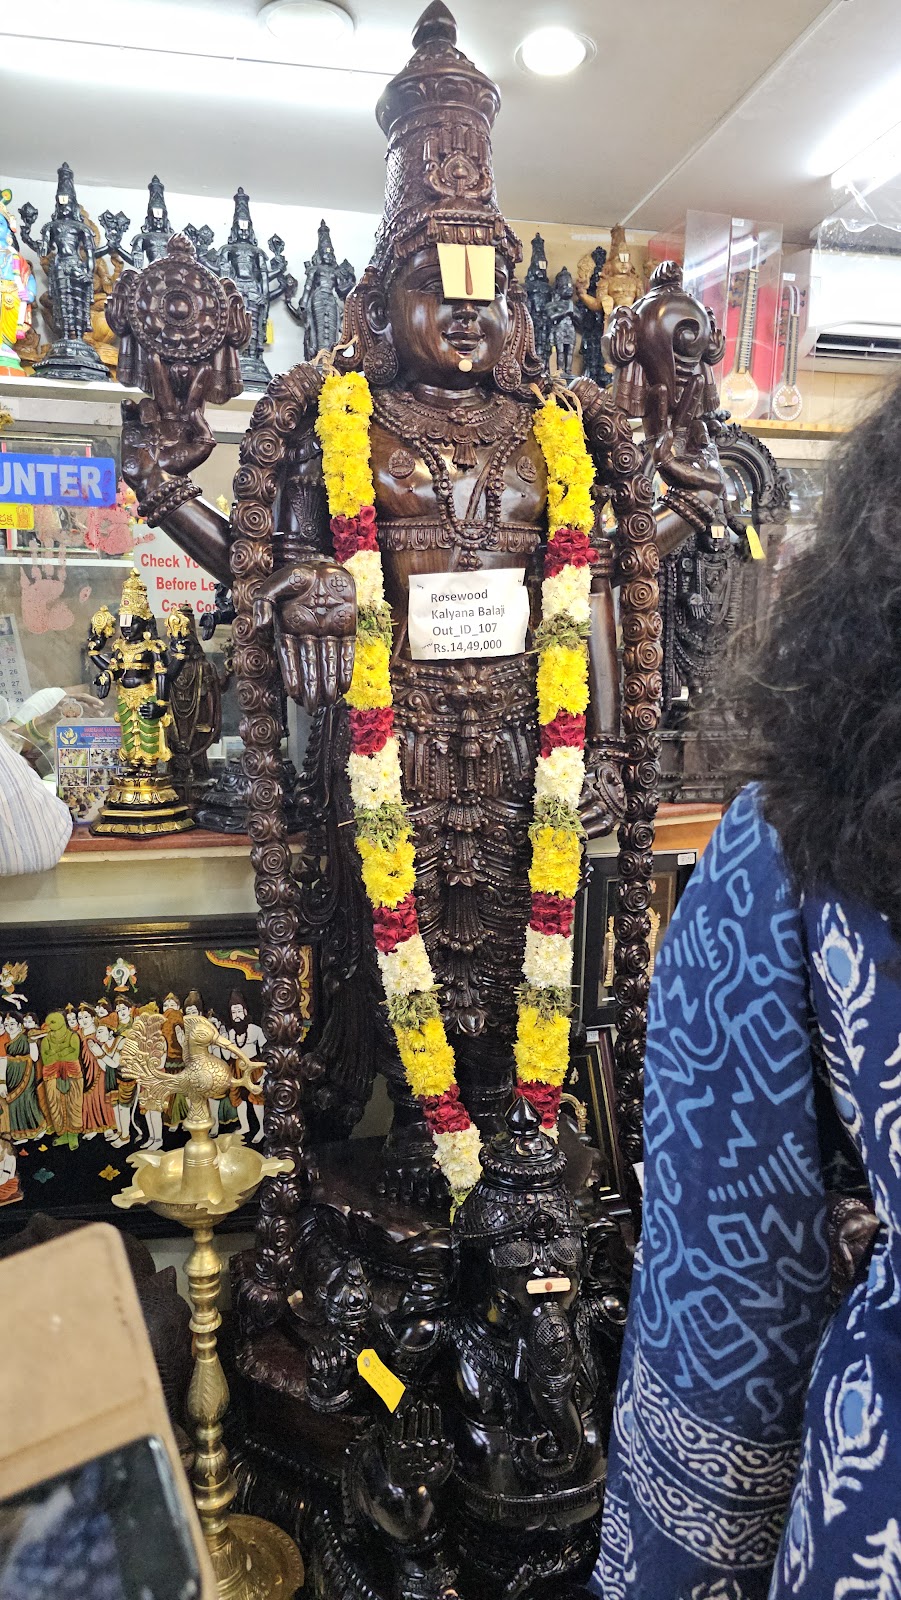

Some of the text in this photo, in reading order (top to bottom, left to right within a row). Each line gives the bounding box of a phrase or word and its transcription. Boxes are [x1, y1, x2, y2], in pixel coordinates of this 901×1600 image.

[0, 462, 103, 499] UNTER
[141, 553, 200, 569] Check Yo
[156, 576, 215, 592] Before Le
[431, 589, 488, 603] Rosewood
[431, 605, 505, 621] Kalyana Balaji
[432, 622, 498, 638] Out_ID_107
[433, 639, 502, 653] Rs.14,49,000
